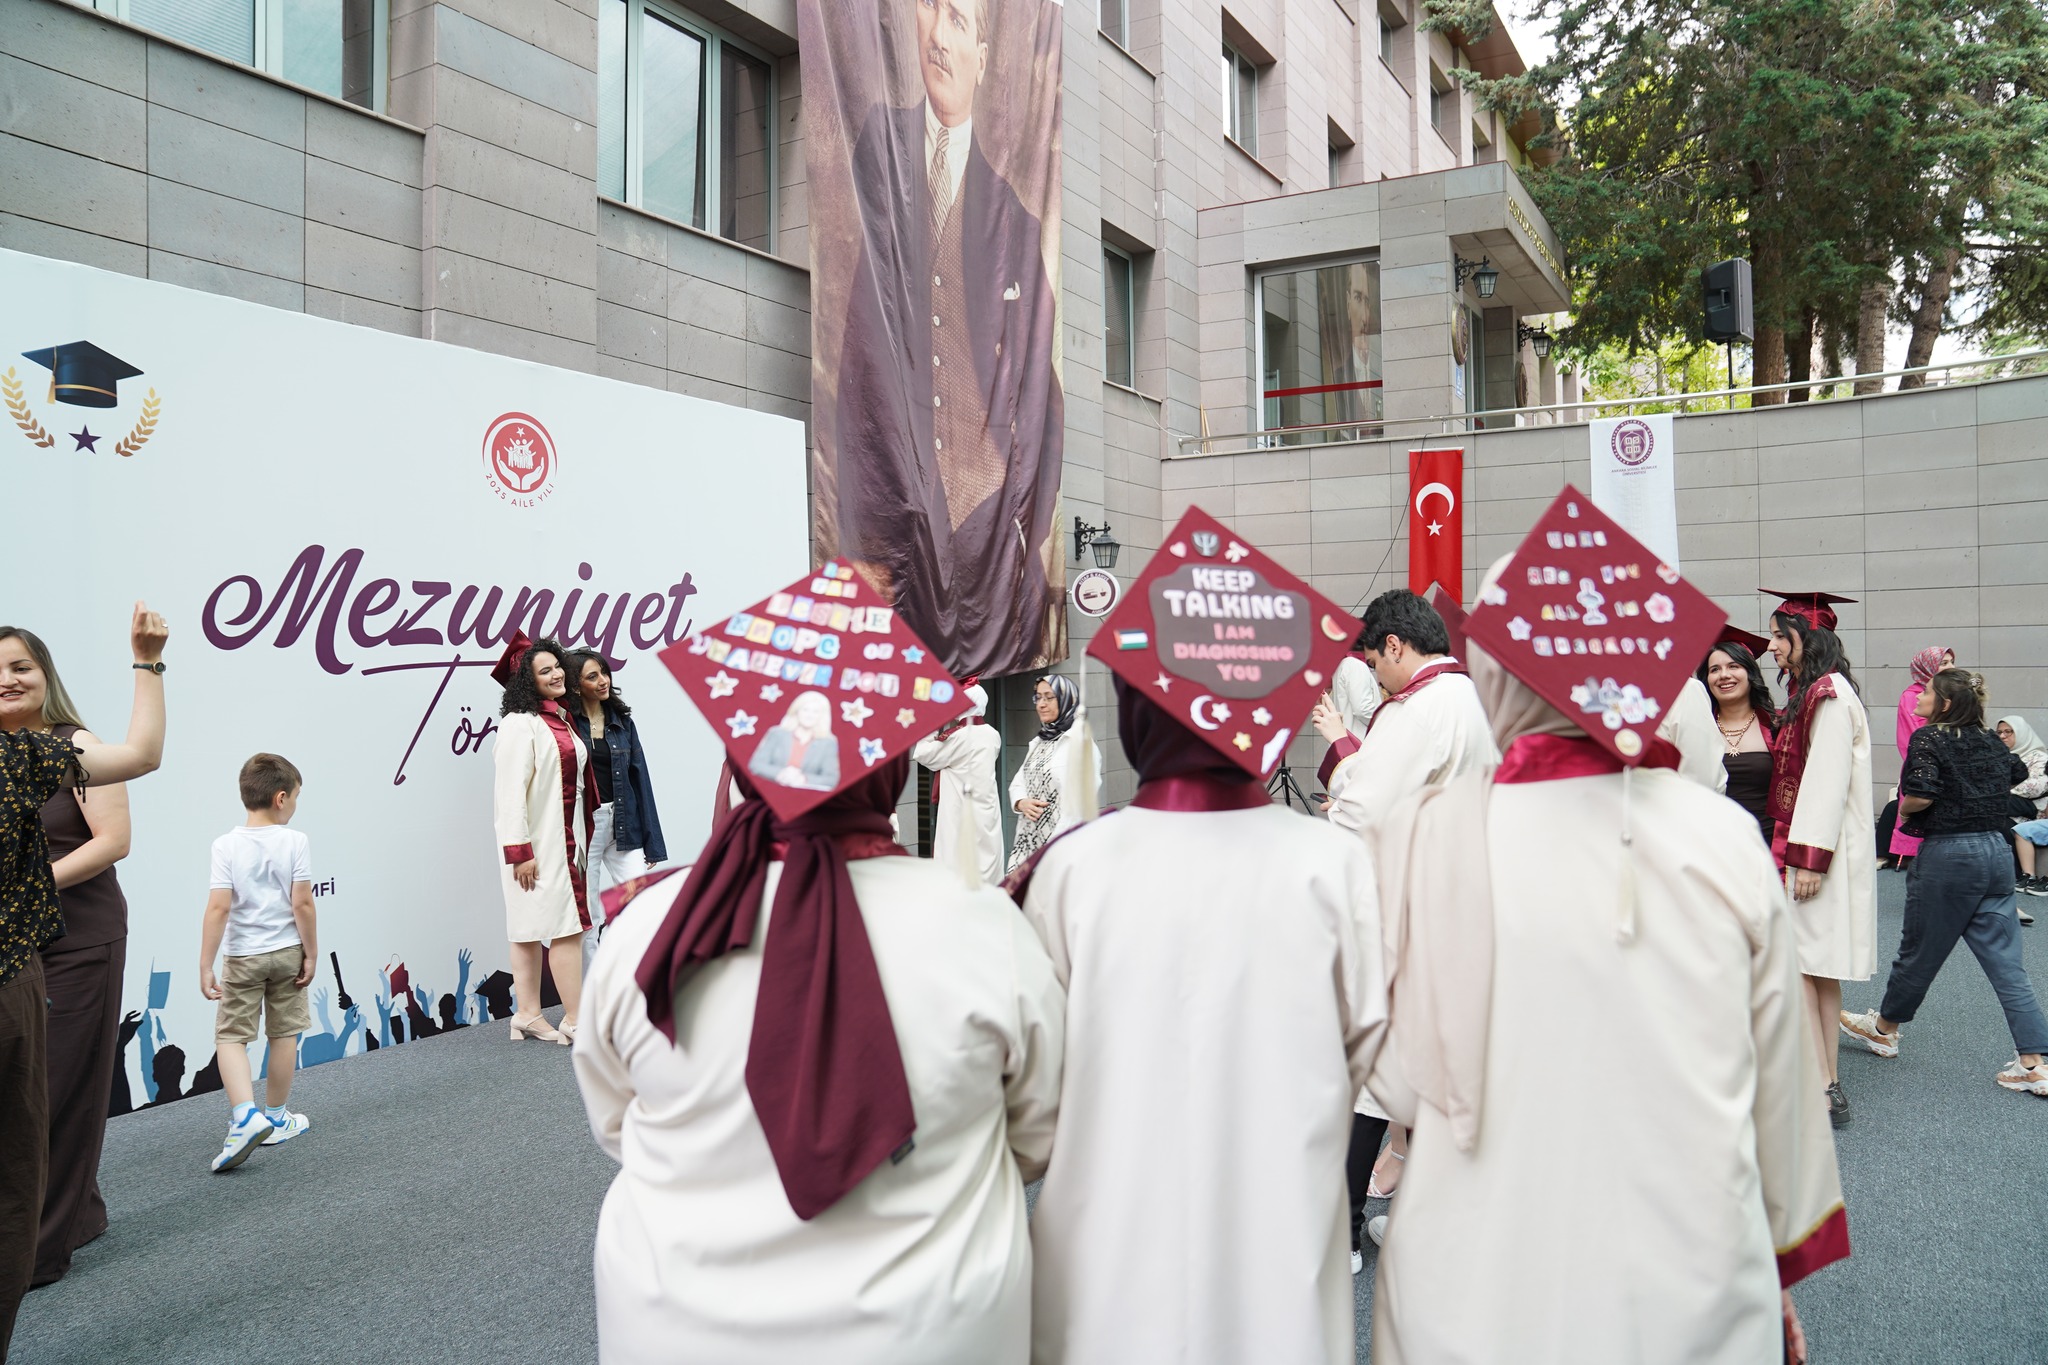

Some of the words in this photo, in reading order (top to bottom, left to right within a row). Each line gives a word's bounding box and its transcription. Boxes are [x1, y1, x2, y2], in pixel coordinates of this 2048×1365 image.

[485, 473, 507, 500] 2025
[511, 497, 535, 508] AİLE
[1191, 567, 1257, 593] KEEP
[201, 543, 698, 676] Mezuniyet
[1163, 590, 1295, 620] TALKING
[1213, 623, 1224, 640] I
[1173, 643, 1295, 662] DIAGNOSING
[1217, 665, 1262, 682] YOU
